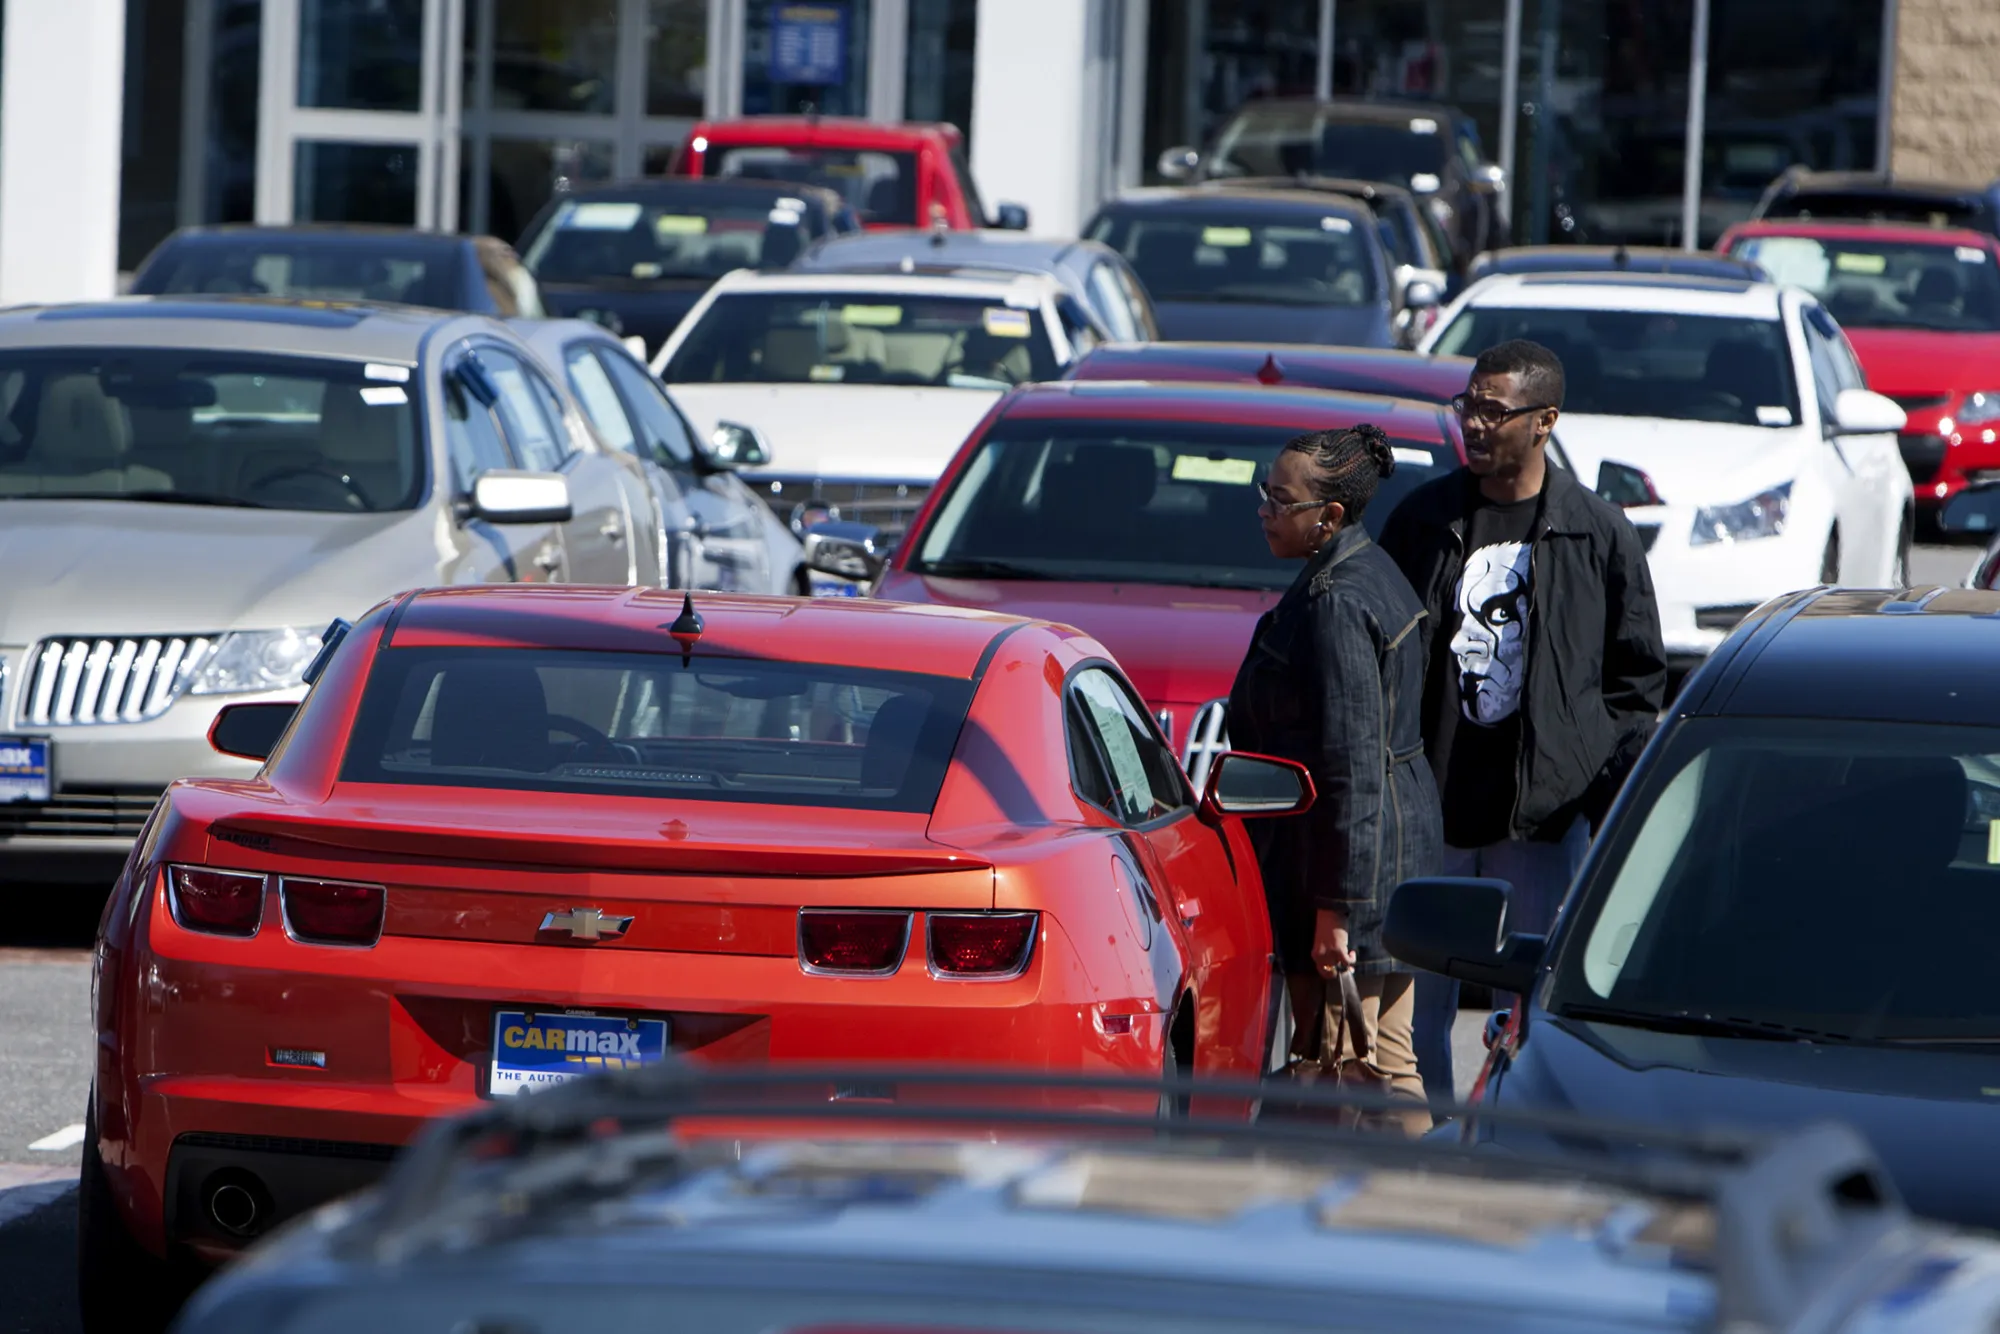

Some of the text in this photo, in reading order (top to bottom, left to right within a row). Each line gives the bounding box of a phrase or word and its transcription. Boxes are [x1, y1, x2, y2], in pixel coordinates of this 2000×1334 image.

[503, 1026, 641, 1058] CARmax
[497, 1071, 521, 1081] THE
[528, 1073, 564, 1084] AUTO
